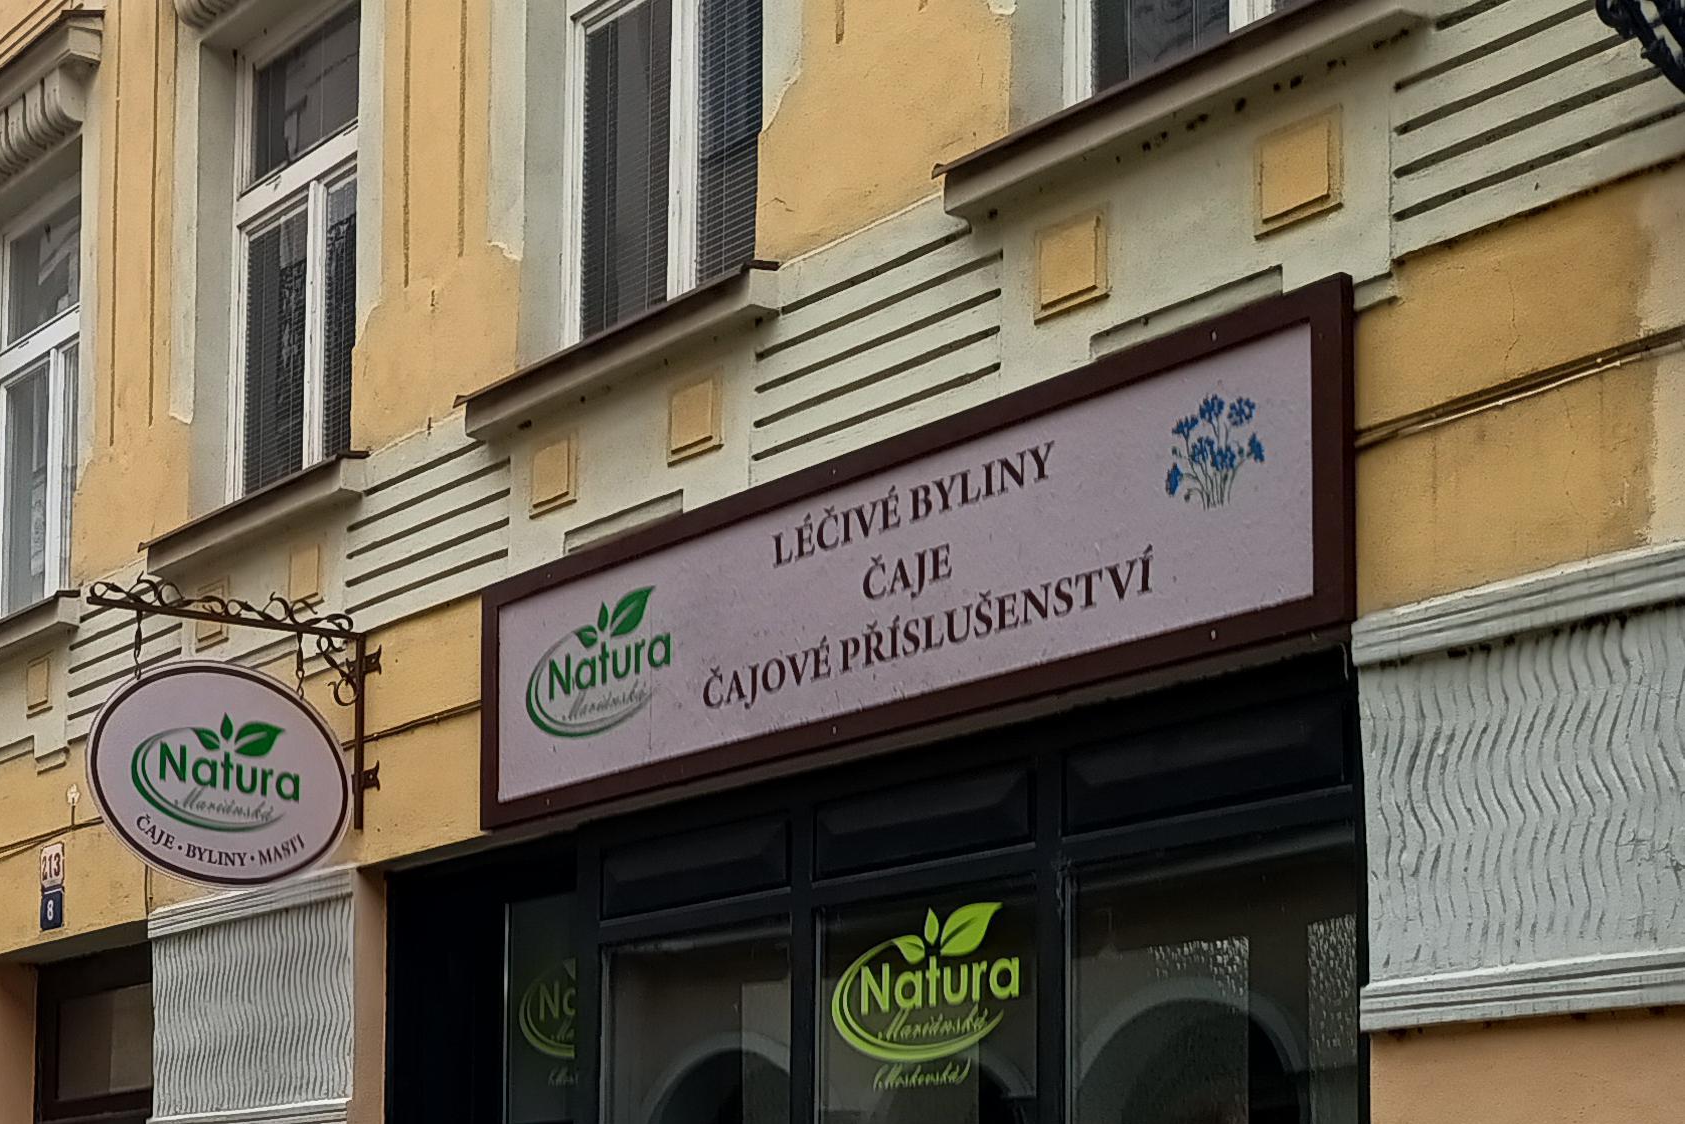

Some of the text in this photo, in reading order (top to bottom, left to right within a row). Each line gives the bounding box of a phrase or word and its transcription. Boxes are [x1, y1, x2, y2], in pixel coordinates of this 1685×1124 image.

[772, 440, 1056, 569] LÉČIVÉ BYLINY
[862, 543, 954, 603] ČAJE
[702, 545, 1154, 711] ČAJOVÉ PŘÍSLUŠENSTVÍ
[549, 632, 672, 701] Natura
[158, 742, 301, 802] Natura
[42, 852, 61, 882] 213
[136, 814, 306, 867] ČAJE BYLINY MASTI
[47, 899, 54, 921] 8
[860, 955, 1020, 1016] Natura
